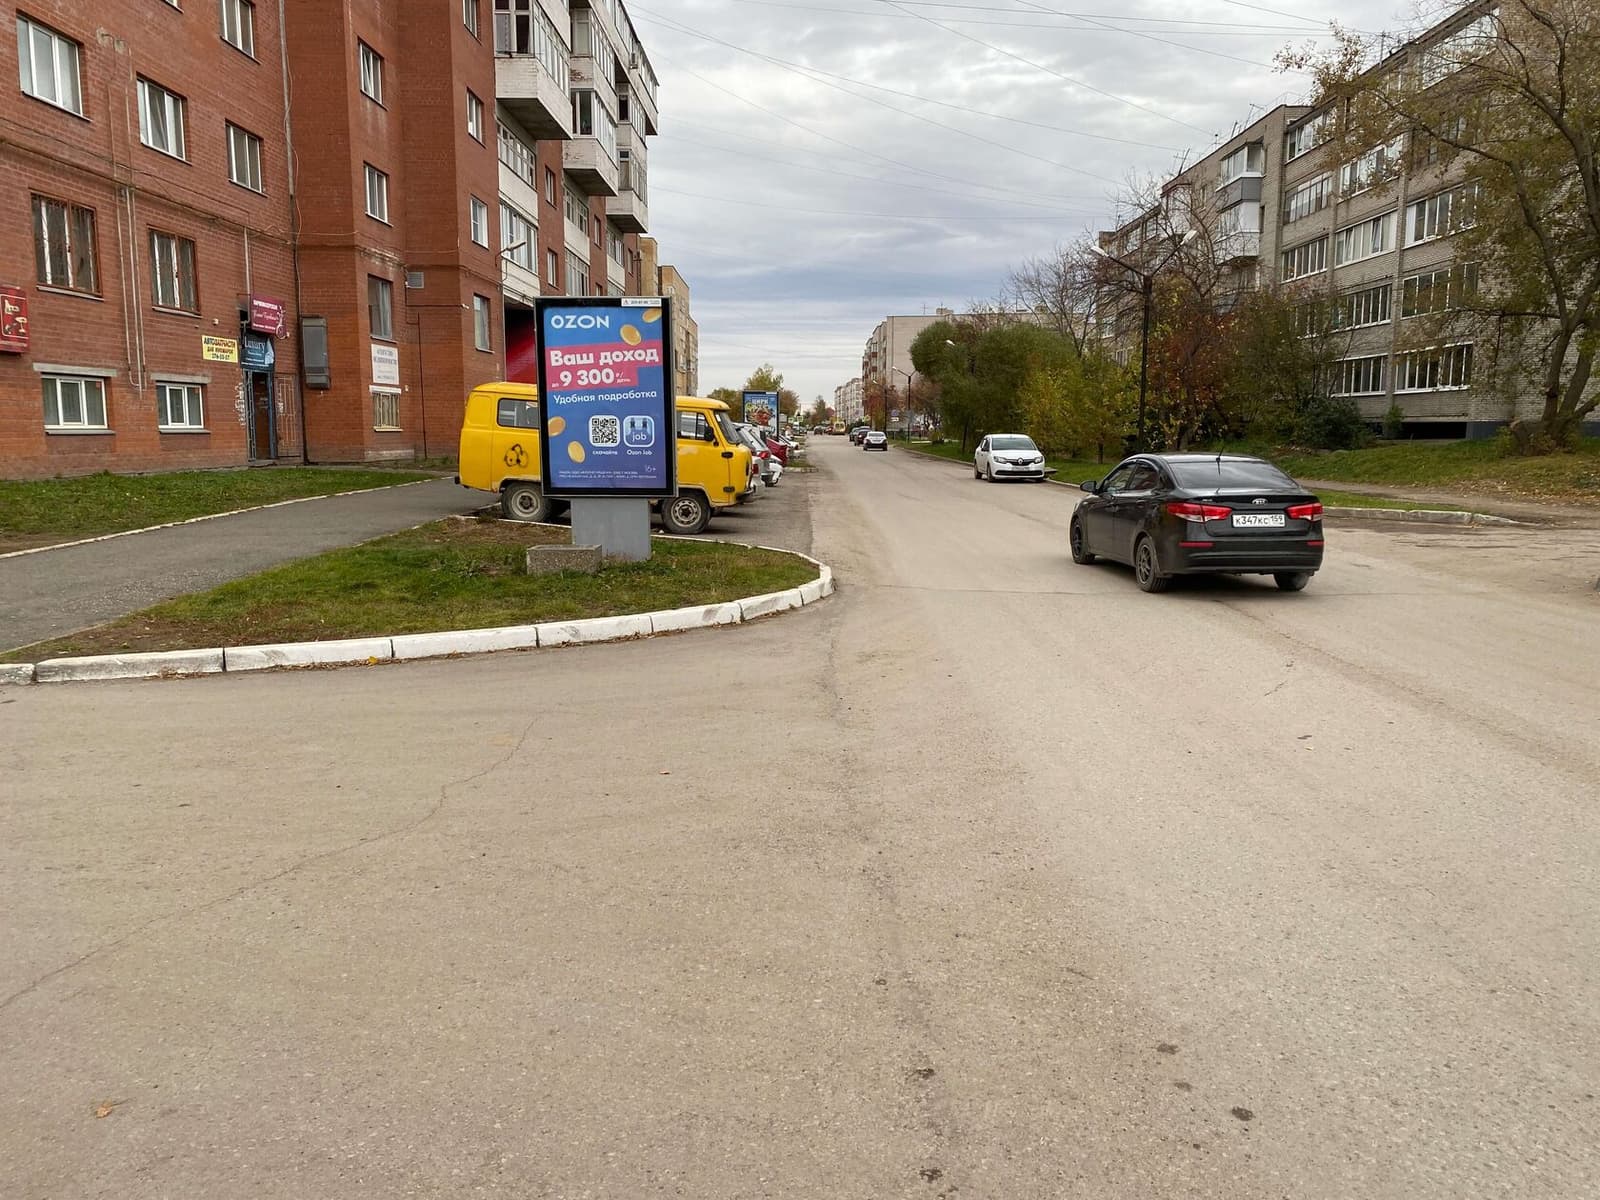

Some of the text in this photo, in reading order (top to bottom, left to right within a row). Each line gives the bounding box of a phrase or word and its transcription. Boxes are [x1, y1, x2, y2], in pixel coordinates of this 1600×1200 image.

[551, 315, 609, 328] OZON
[550, 348, 659, 366] Ваш доход
[560, 371, 572, 386] 9
[577, 368, 615, 385] 300
[553, 390, 657, 404] Удобная подработка
[632, 433, 647, 442] job
